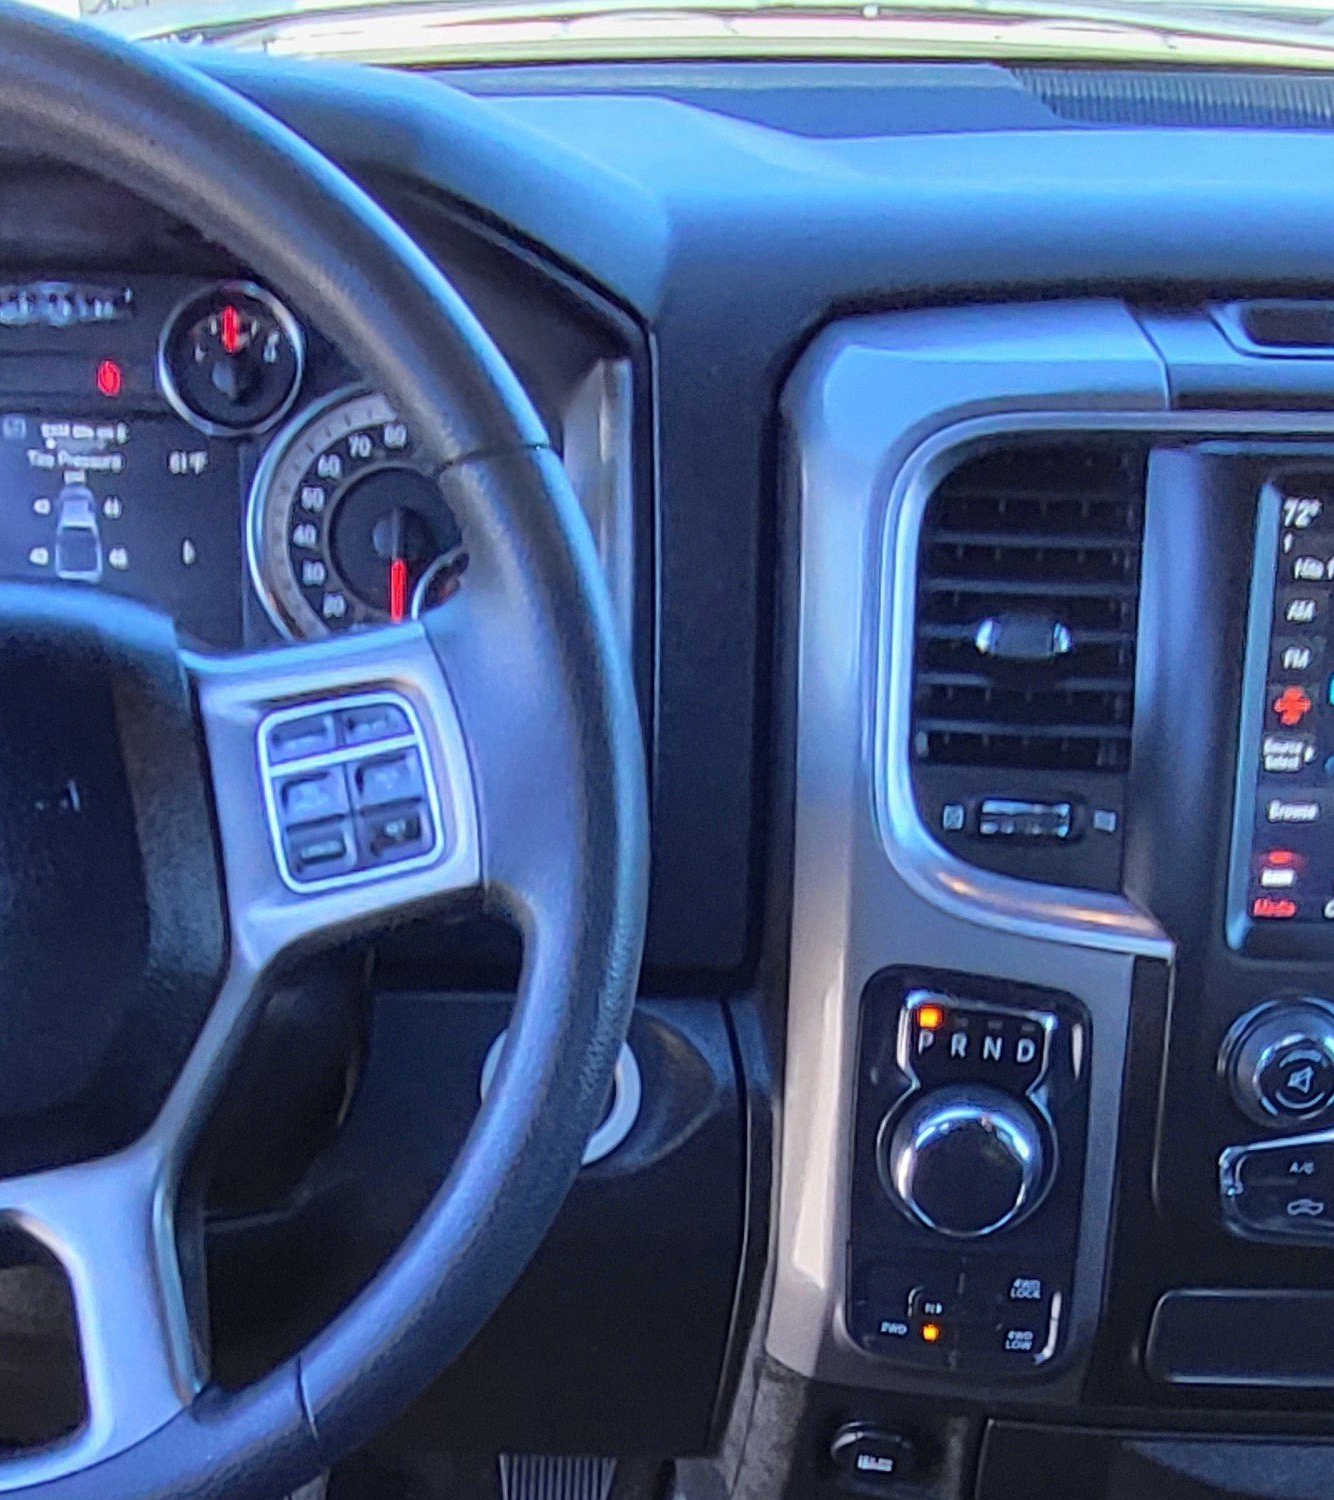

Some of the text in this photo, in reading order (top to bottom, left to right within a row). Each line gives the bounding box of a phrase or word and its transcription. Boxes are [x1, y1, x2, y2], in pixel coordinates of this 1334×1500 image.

[348, 433, 373, 458] 70
[27, 449, 123, 473] Tire Pressure
[318, 453, 342, 480] 60
[301, 486, 325, 512] 50
[293, 522, 317, 548] 40
[302, 560, 326, 586] 30
[1286, 599, 1317, 622] AM
[1282, 647, 1310, 670] FM
[1268, 799, 1319, 823] Browse
[1252, 897, 1298, 919] Media
[918, 1029, 935, 1056] P
[950, 1032, 968, 1059] R
[982, 1035, 1003, 1062] N
[1016, 1037, 1036, 1064] D
[1289, 1161, 1316, 1175] A/C
[1010, 1287, 1041, 1300] LOCK
[1013, 1278, 1042, 1289] 4WD
[1005, 1339, 1033, 1351] LOW
[1008, 1329, 1034, 1341] 4WD
